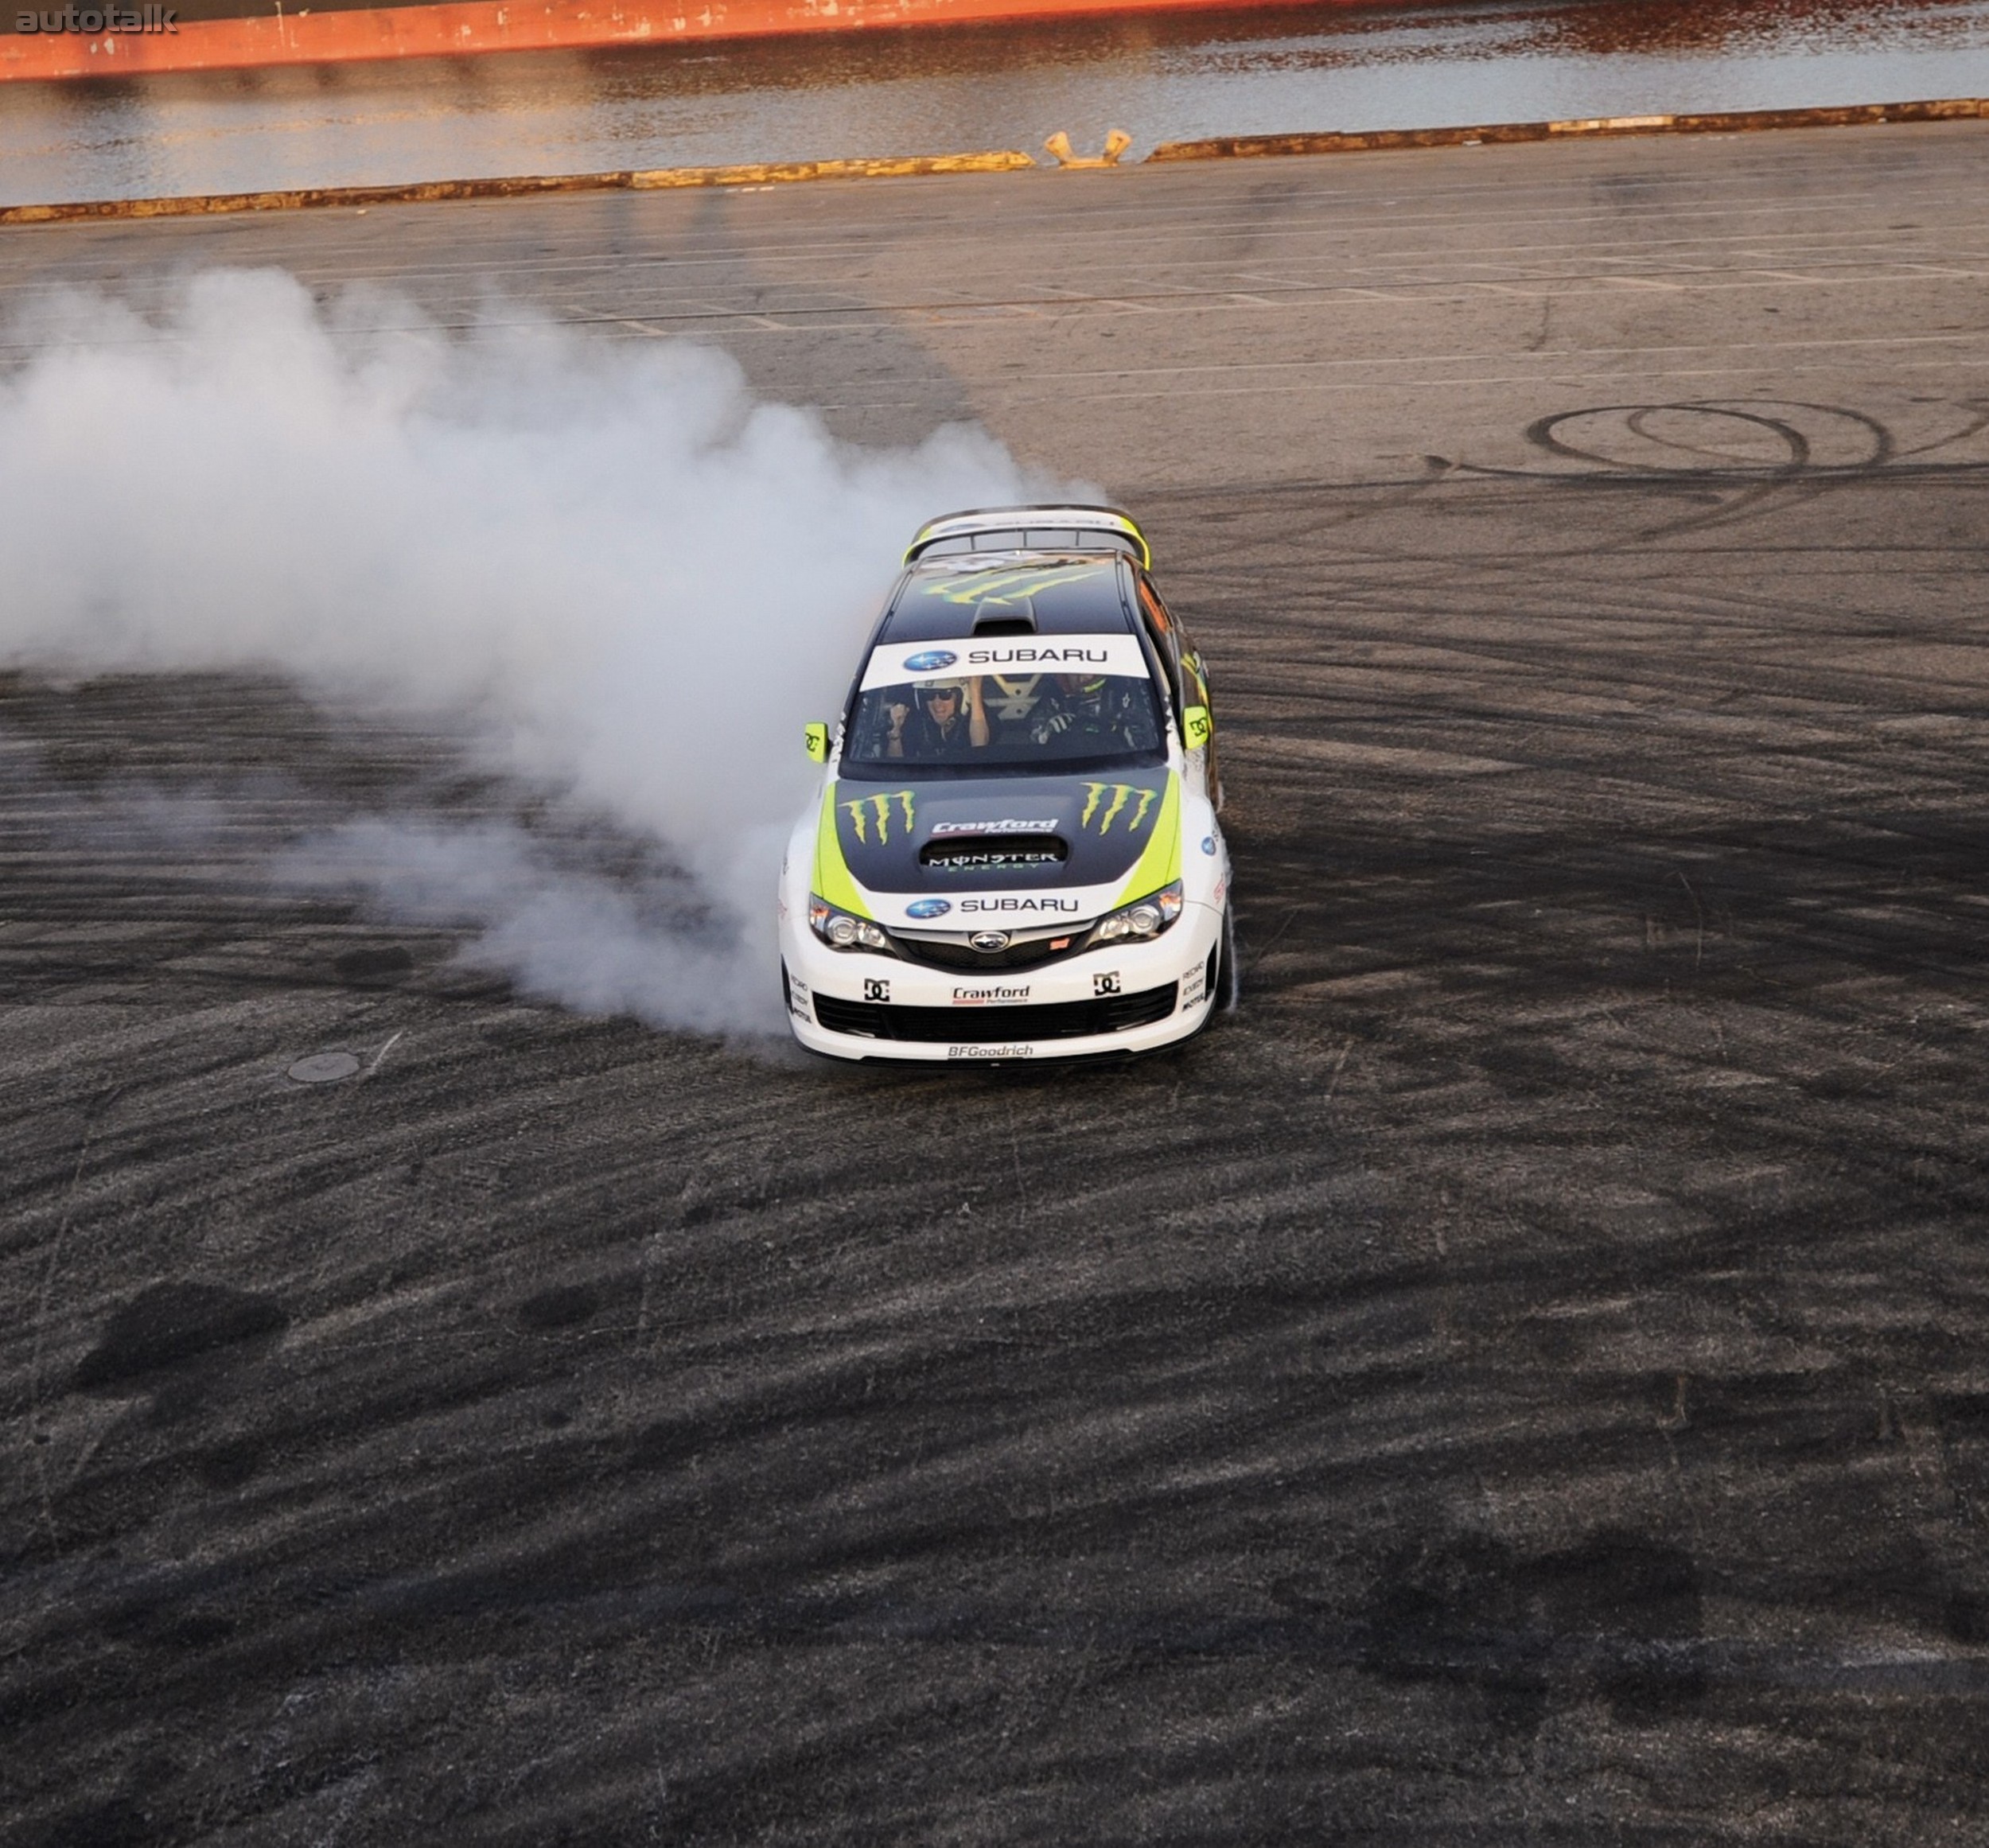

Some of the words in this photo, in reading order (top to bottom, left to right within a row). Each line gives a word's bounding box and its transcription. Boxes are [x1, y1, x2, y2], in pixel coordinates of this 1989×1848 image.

[968, 649, 1107, 663] SUBARU
[932, 819, 1059, 834] Crawford
[928, 854, 1058, 866] MONSTER
[948, 862, 1040, 873] ENERGY
[959, 898, 1079, 912] SUBARU
[952, 986, 1030, 999] Crawford
[948, 1045, 1033, 1056] BFGoodrich
